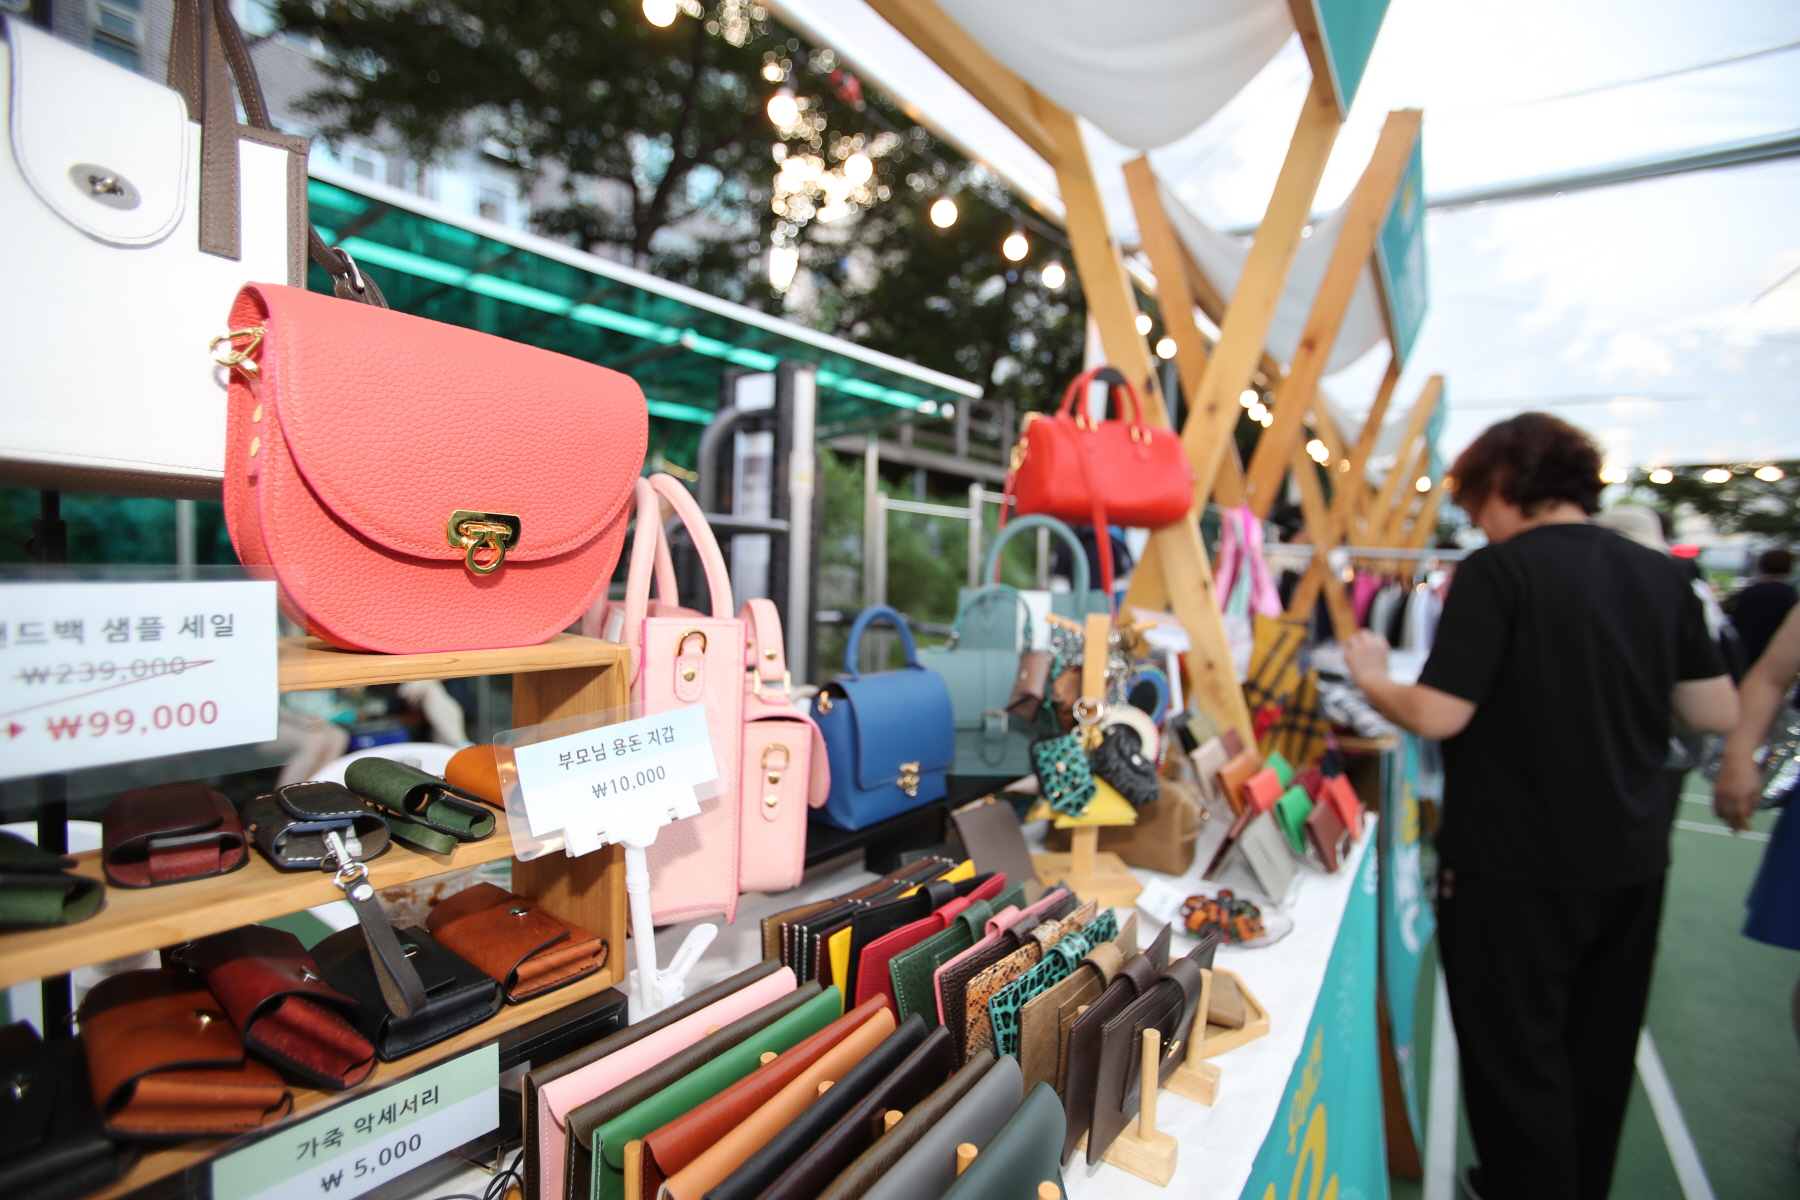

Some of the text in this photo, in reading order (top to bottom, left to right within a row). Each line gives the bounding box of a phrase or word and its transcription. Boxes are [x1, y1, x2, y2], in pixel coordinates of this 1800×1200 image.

[102, 615, 166, 643] 샘플
[178, 613, 235, 639] 세일
[46, 700, 219, 741] ₩99,000
[558, 724, 676, 770] 부모님 용돈 지갑
[592, 765, 667, 799] ₩10,000
[297, 1084, 440, 1161] 가죽 악세서리
[353, 1133, 422, 1179] 5,000
